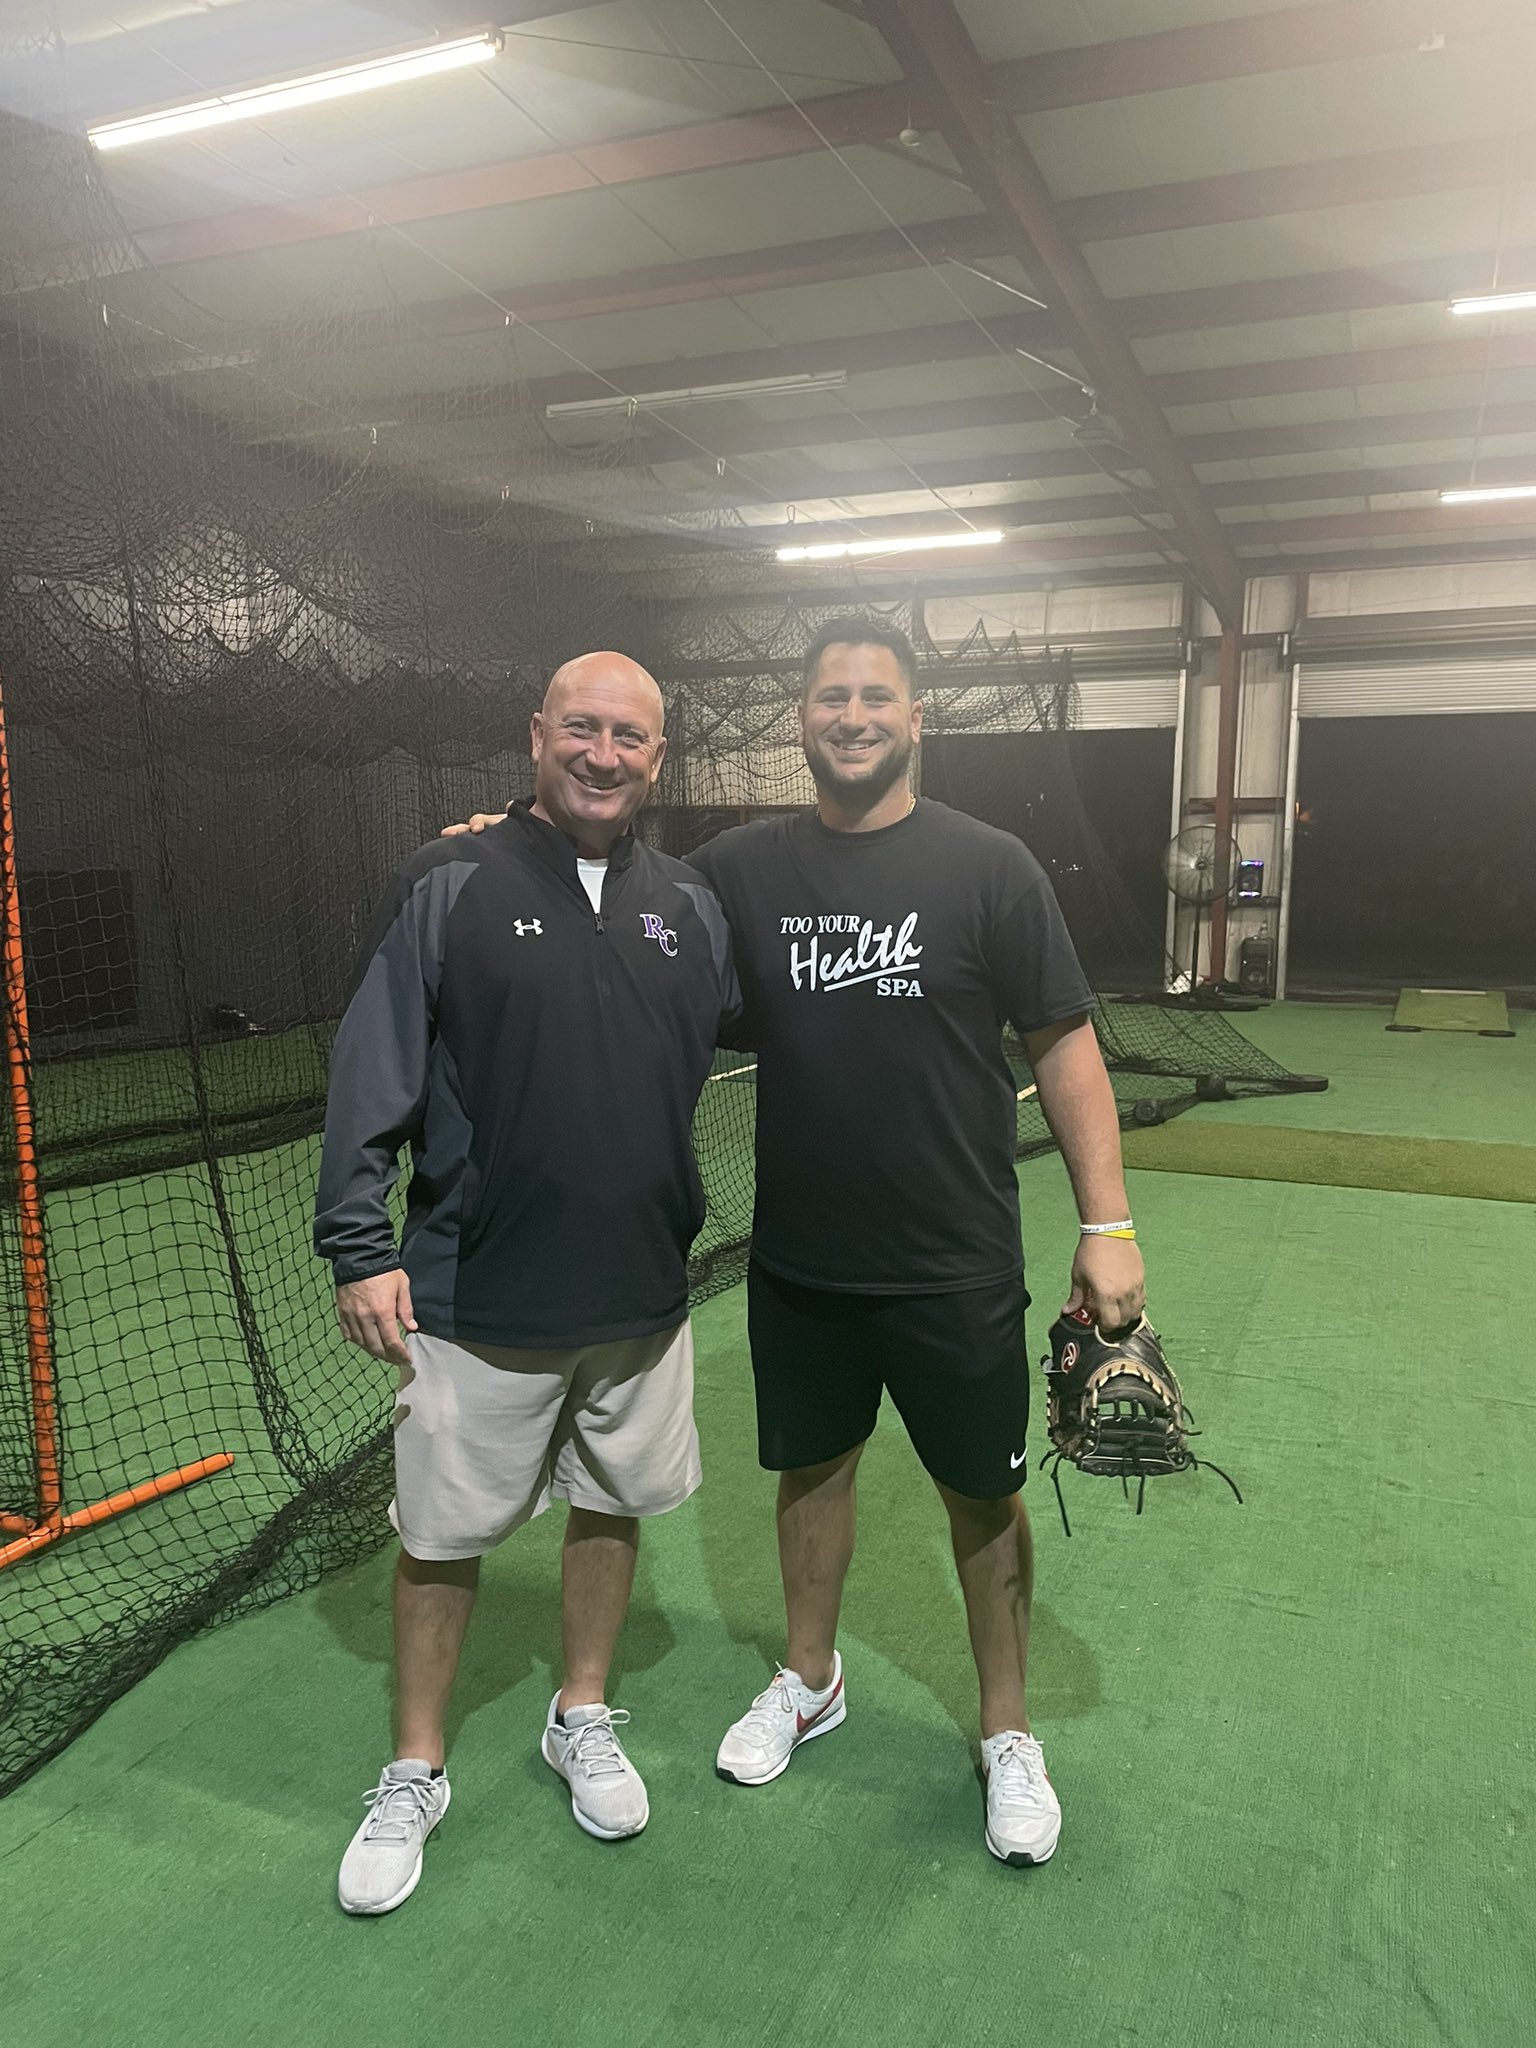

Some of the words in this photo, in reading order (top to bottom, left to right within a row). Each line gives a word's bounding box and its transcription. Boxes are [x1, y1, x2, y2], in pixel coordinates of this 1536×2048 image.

[639, 913, 678, 957] RC
[780, 916, 813, 934] TOO
[817, 915, 861, 933] YOUR
[790, 911, 924, 992] Health
[876, 977, 925, 998] SPA
